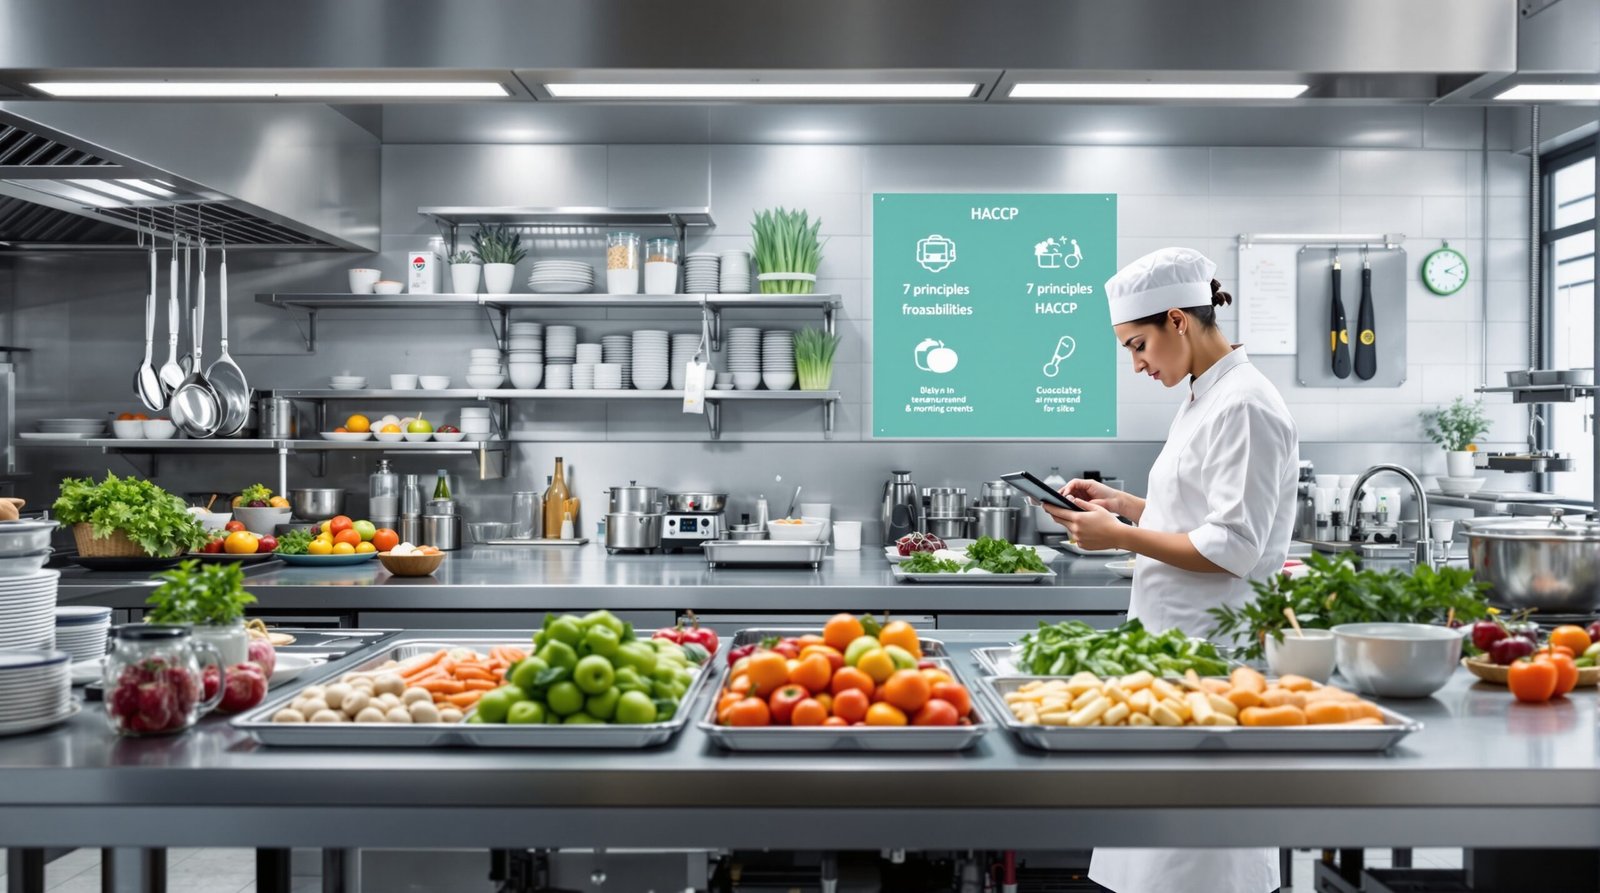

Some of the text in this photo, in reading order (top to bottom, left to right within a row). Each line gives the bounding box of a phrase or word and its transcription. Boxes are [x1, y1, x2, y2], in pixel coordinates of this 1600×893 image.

[970, 206, 1019, 220] HACCP
[903, 283, 970, 297] 7 principles
[1026, 282, 1093, 297] 7 principles
[1035, 302, 1078, 314] HACCP
[1043, 404, 1055, 412] for
